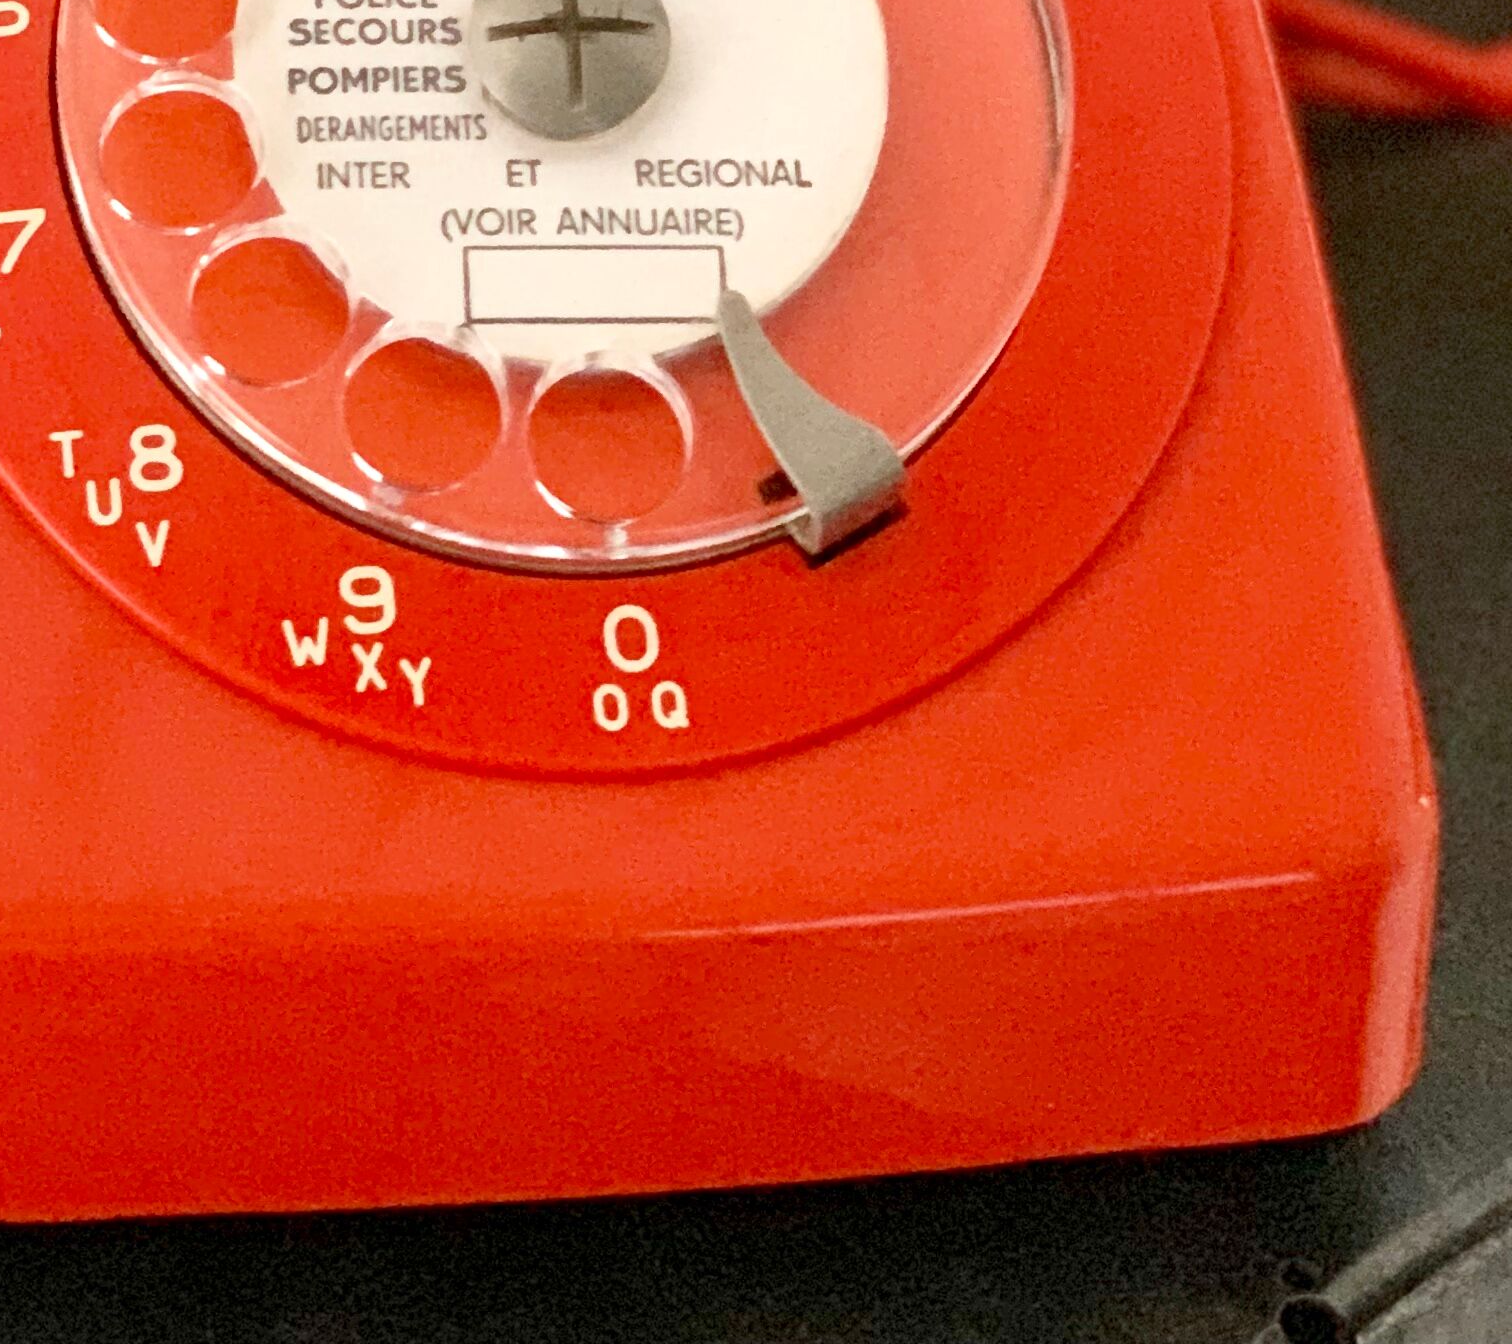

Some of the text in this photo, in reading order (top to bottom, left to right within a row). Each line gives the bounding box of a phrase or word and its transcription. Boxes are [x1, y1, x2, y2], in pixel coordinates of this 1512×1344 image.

[287, 15, 465, 48] SECOURS
[287, 63, 469, 97] POMPIERS
[295, 111, 489, 145] DERANGEMENTS
[316, 157, 814, 191] INTER ET REGIONAL
[440, 205, 746, 243] (VOIR ANNUAIRE)
[128, 423, 184, 493] 8
[338, 564, 397, 635] 9
[602, 603, 660, 673] 0
